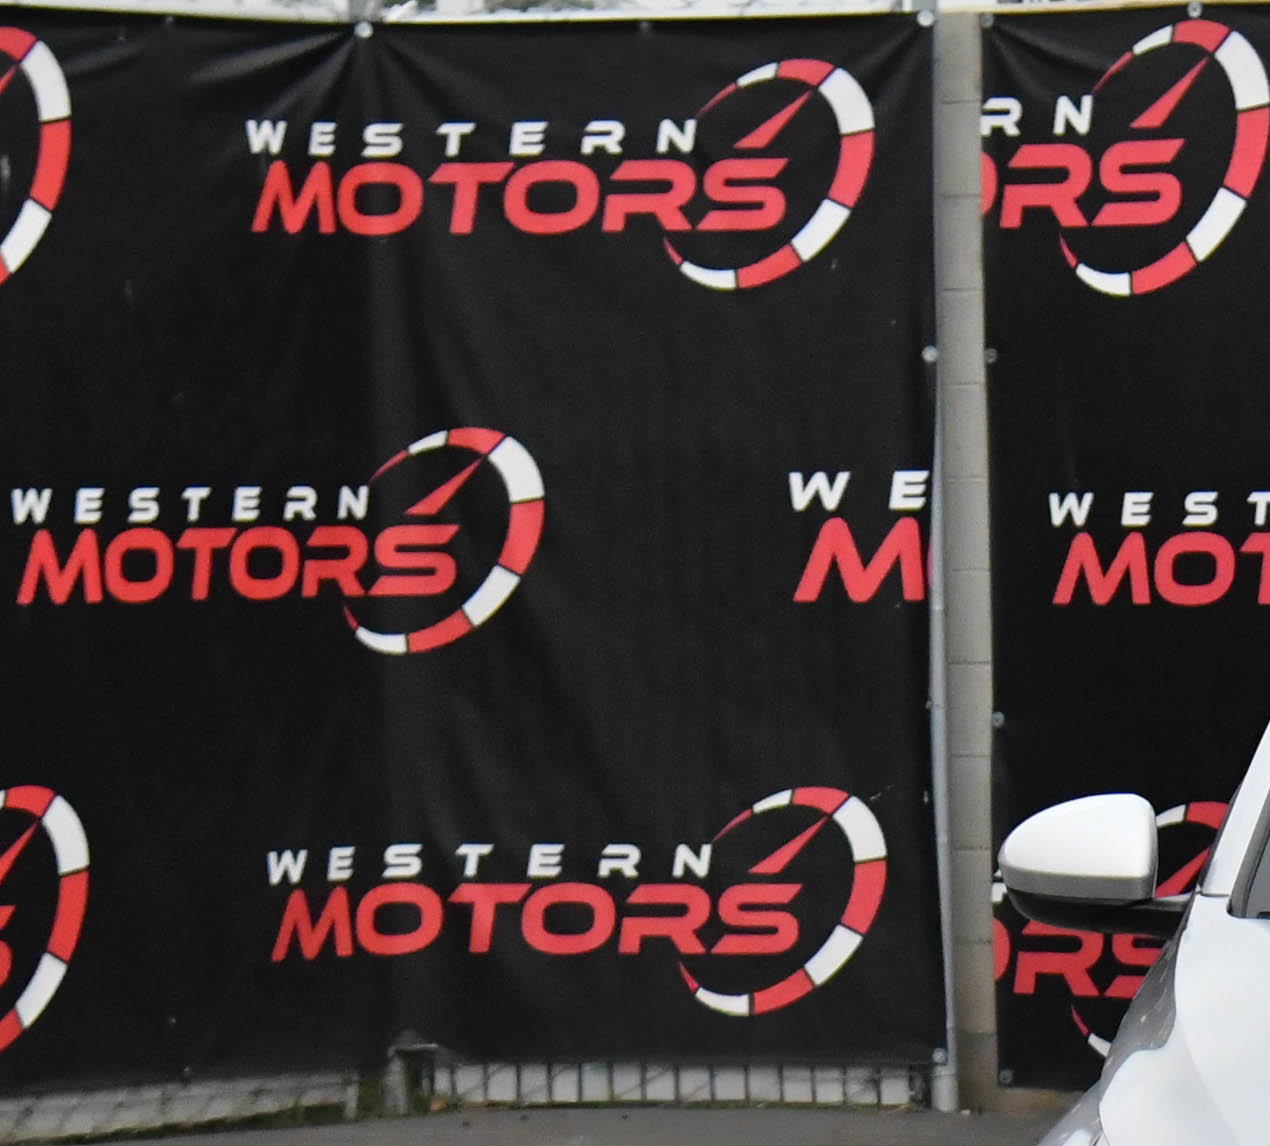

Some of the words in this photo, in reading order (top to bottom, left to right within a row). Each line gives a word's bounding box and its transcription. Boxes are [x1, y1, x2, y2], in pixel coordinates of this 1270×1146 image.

[247, 118, 697, 157] WESTERN
[252, 157, 788, 236] MOTORS
[12, 485, 369, 524] WESTERN
[17, 524, 459, 605] MOTORS
[793, 516, 933, 603] M
[268, 843, 712, 885] WESTERN
[271, 882, 802, 961] MOTORS
